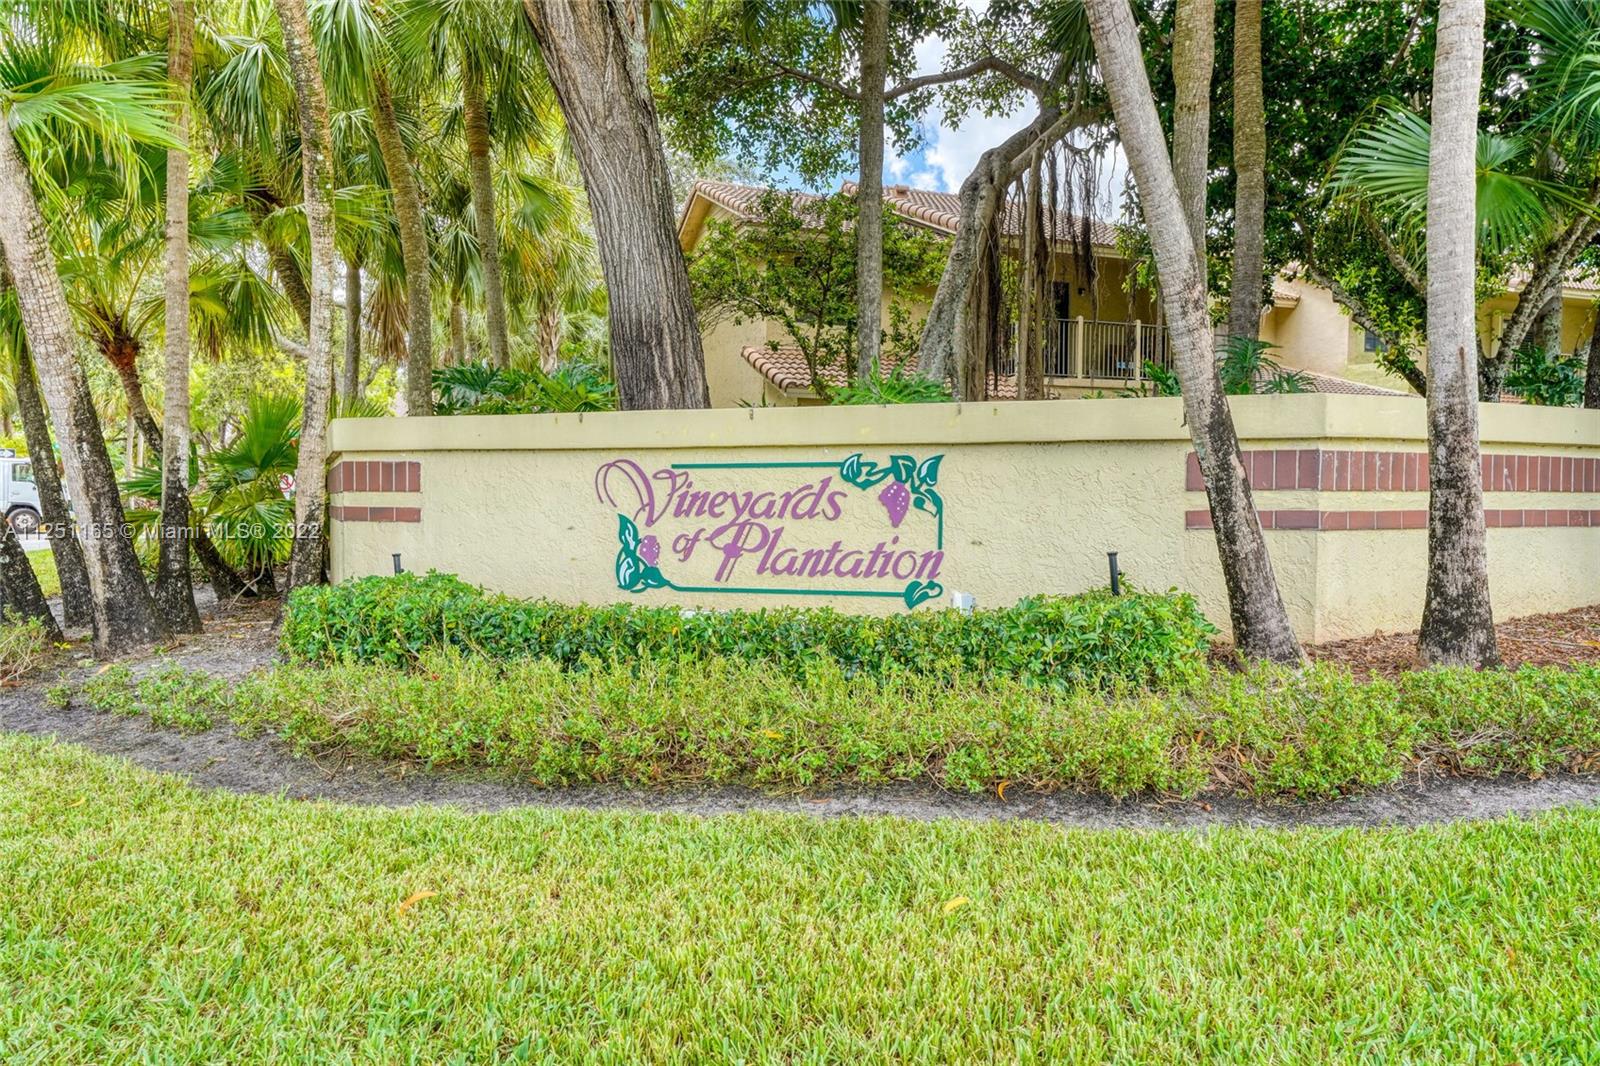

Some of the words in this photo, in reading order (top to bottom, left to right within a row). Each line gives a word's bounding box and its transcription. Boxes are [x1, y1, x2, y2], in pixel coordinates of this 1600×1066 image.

[595, 459, 848, 527] Vineyards
[672, 527, 706, 562] of
[704, 518, 945, 581] Plantation
